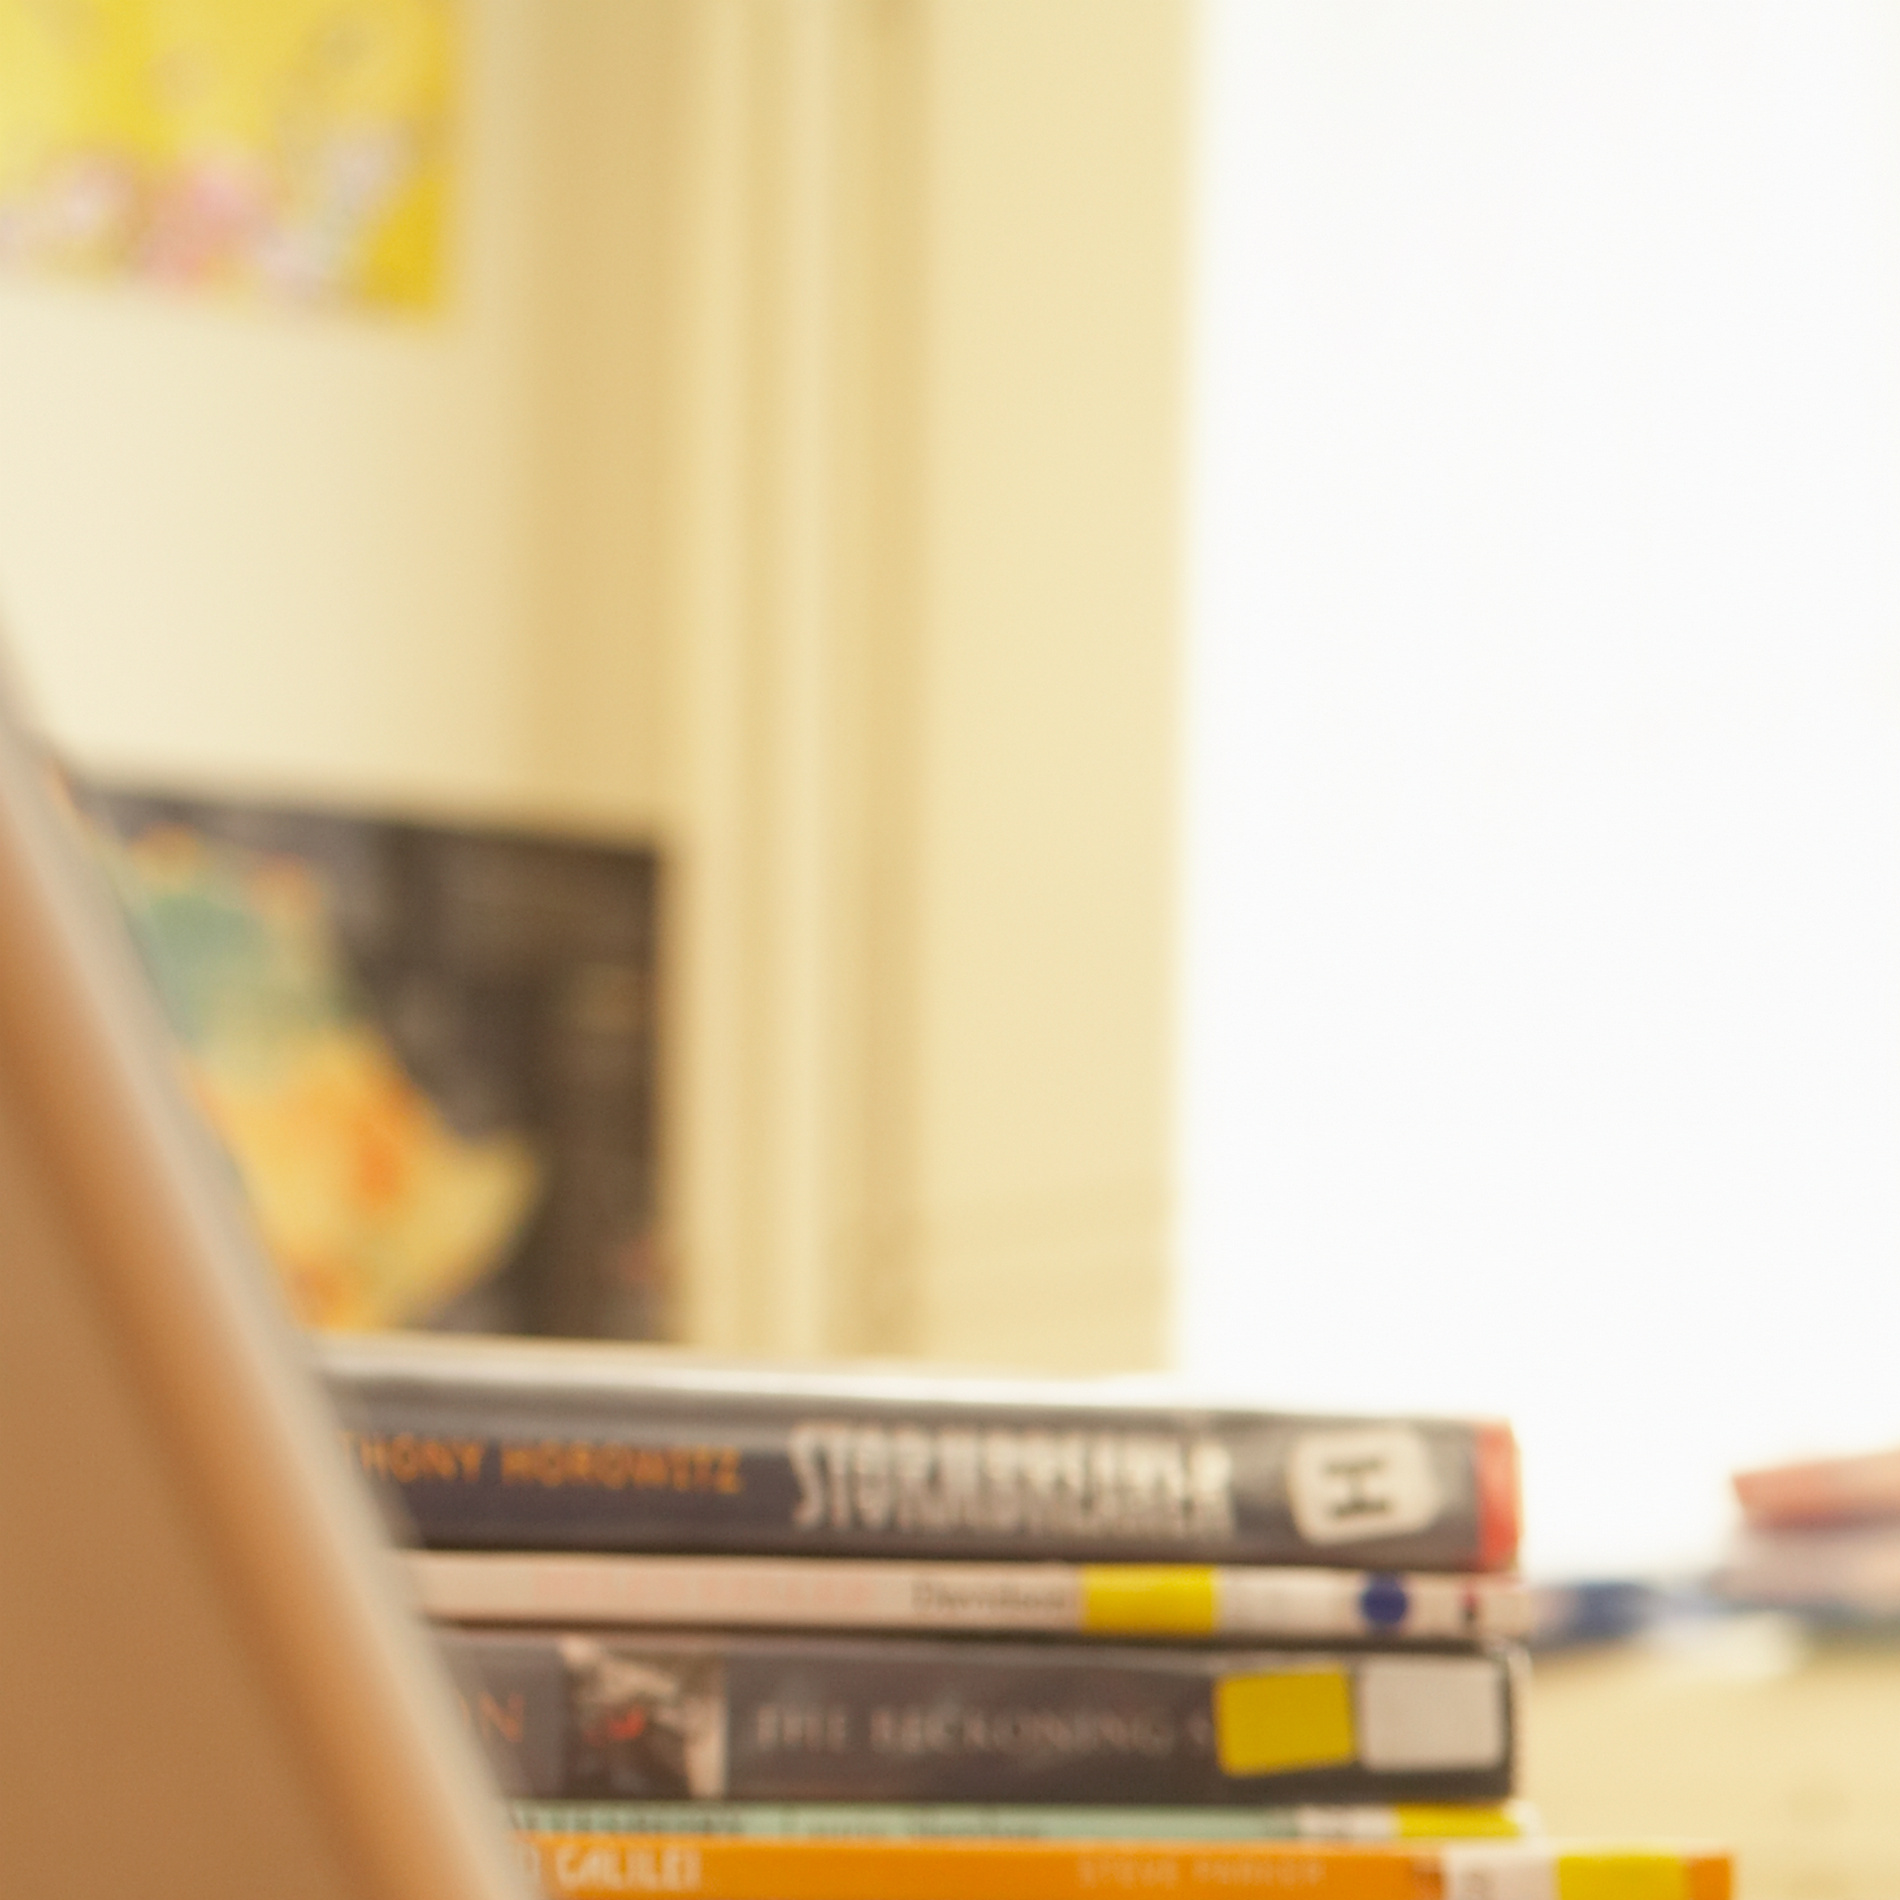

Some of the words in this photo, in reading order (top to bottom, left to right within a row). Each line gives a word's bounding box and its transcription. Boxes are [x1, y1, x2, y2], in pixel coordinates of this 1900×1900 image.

[502, 1437, 741, 1496] HOROWITZ
[754, 1702, 847, 1752] THE
[868, 1703, 1174, 1757] RECKONING
